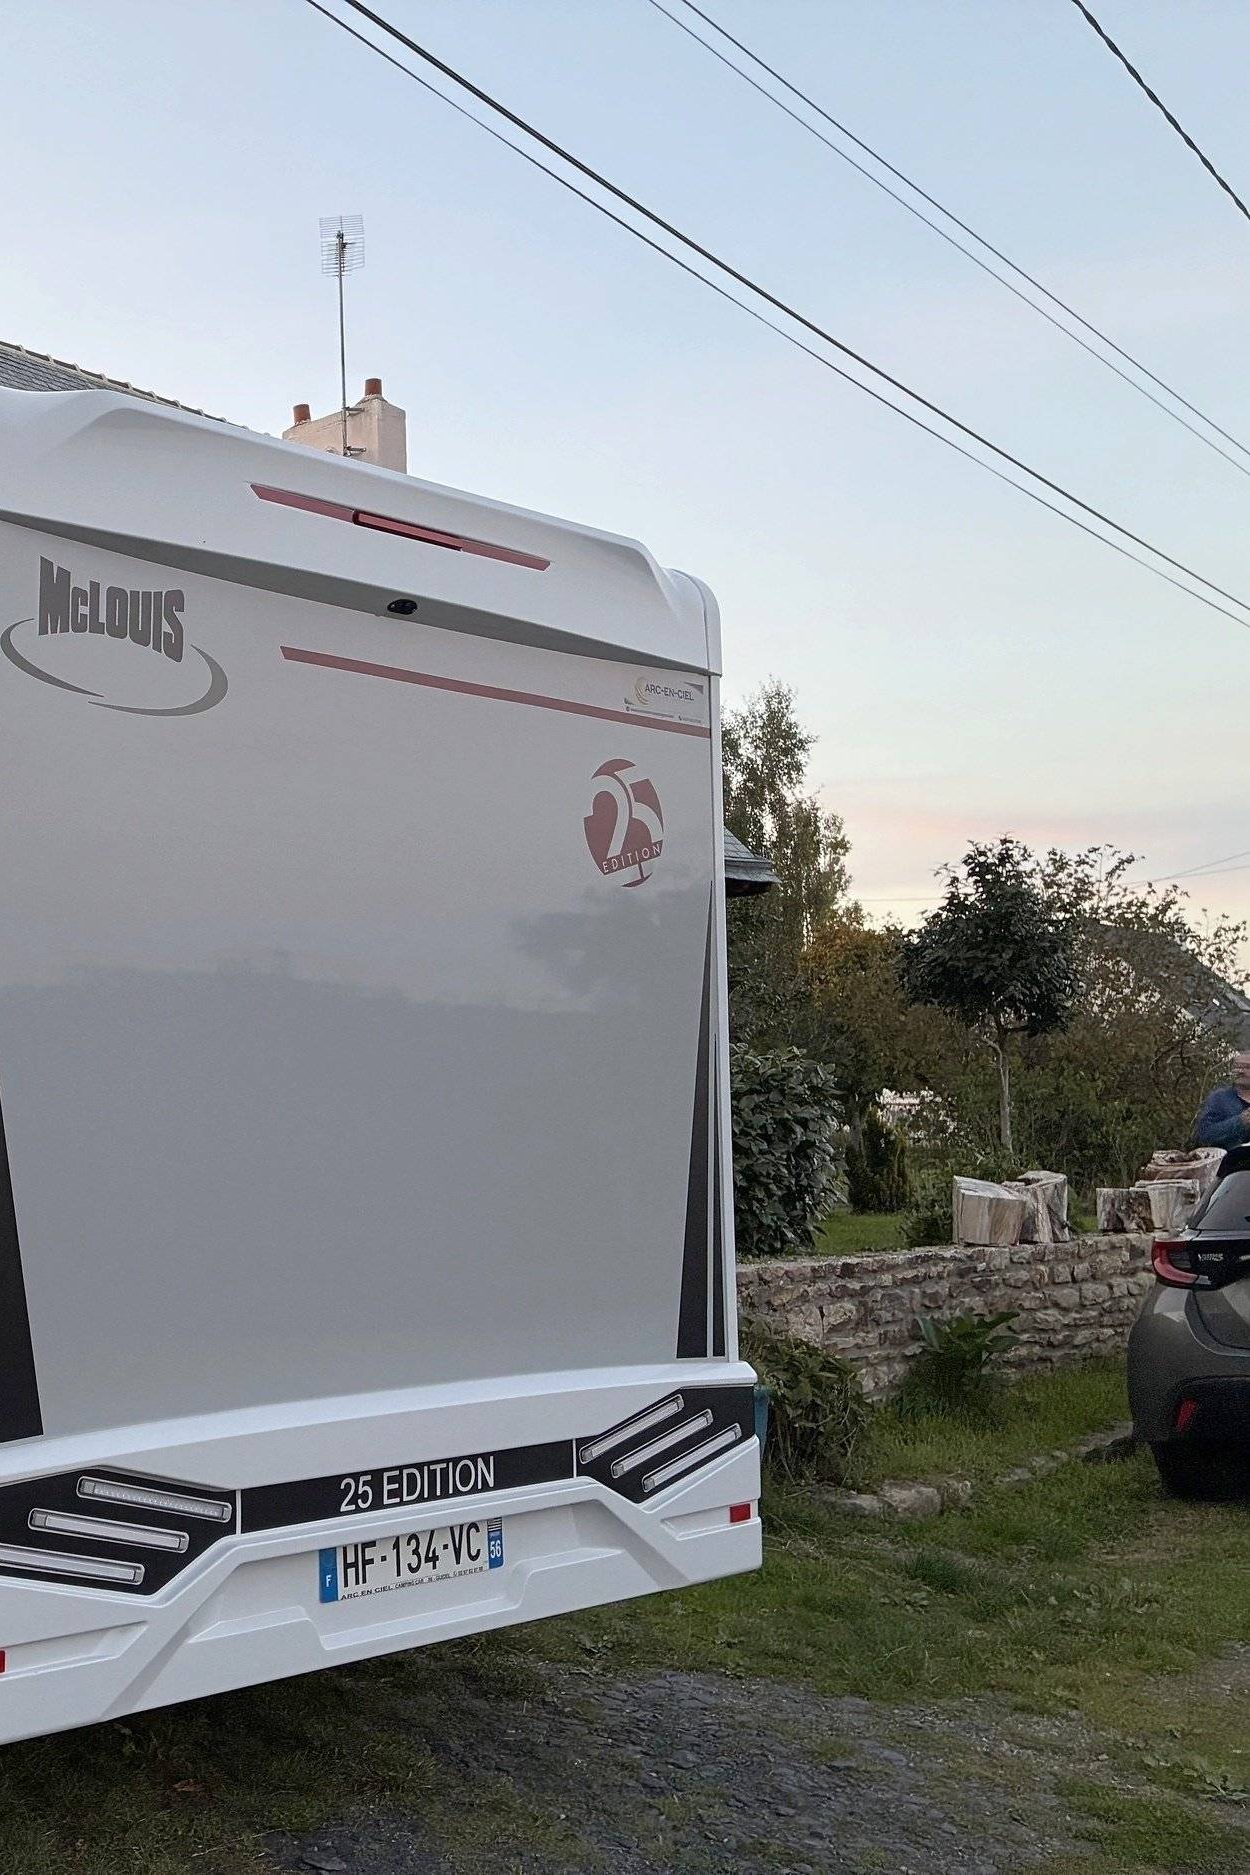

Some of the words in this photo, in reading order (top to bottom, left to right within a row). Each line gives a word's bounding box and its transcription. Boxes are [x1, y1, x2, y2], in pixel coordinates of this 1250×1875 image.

[644, 683, 695, 701] ARC-EN-CIEL
[602, 844, 661, 874] EDITION
[340, 1474, 373, 1512] 25
[383, 1456, 494, 1505] EDITION
[342, 1521, 481, 1588] HF-134-VC
[490, 1539, 502, 1559] 56
[325, 1574, 332, 1588] F
